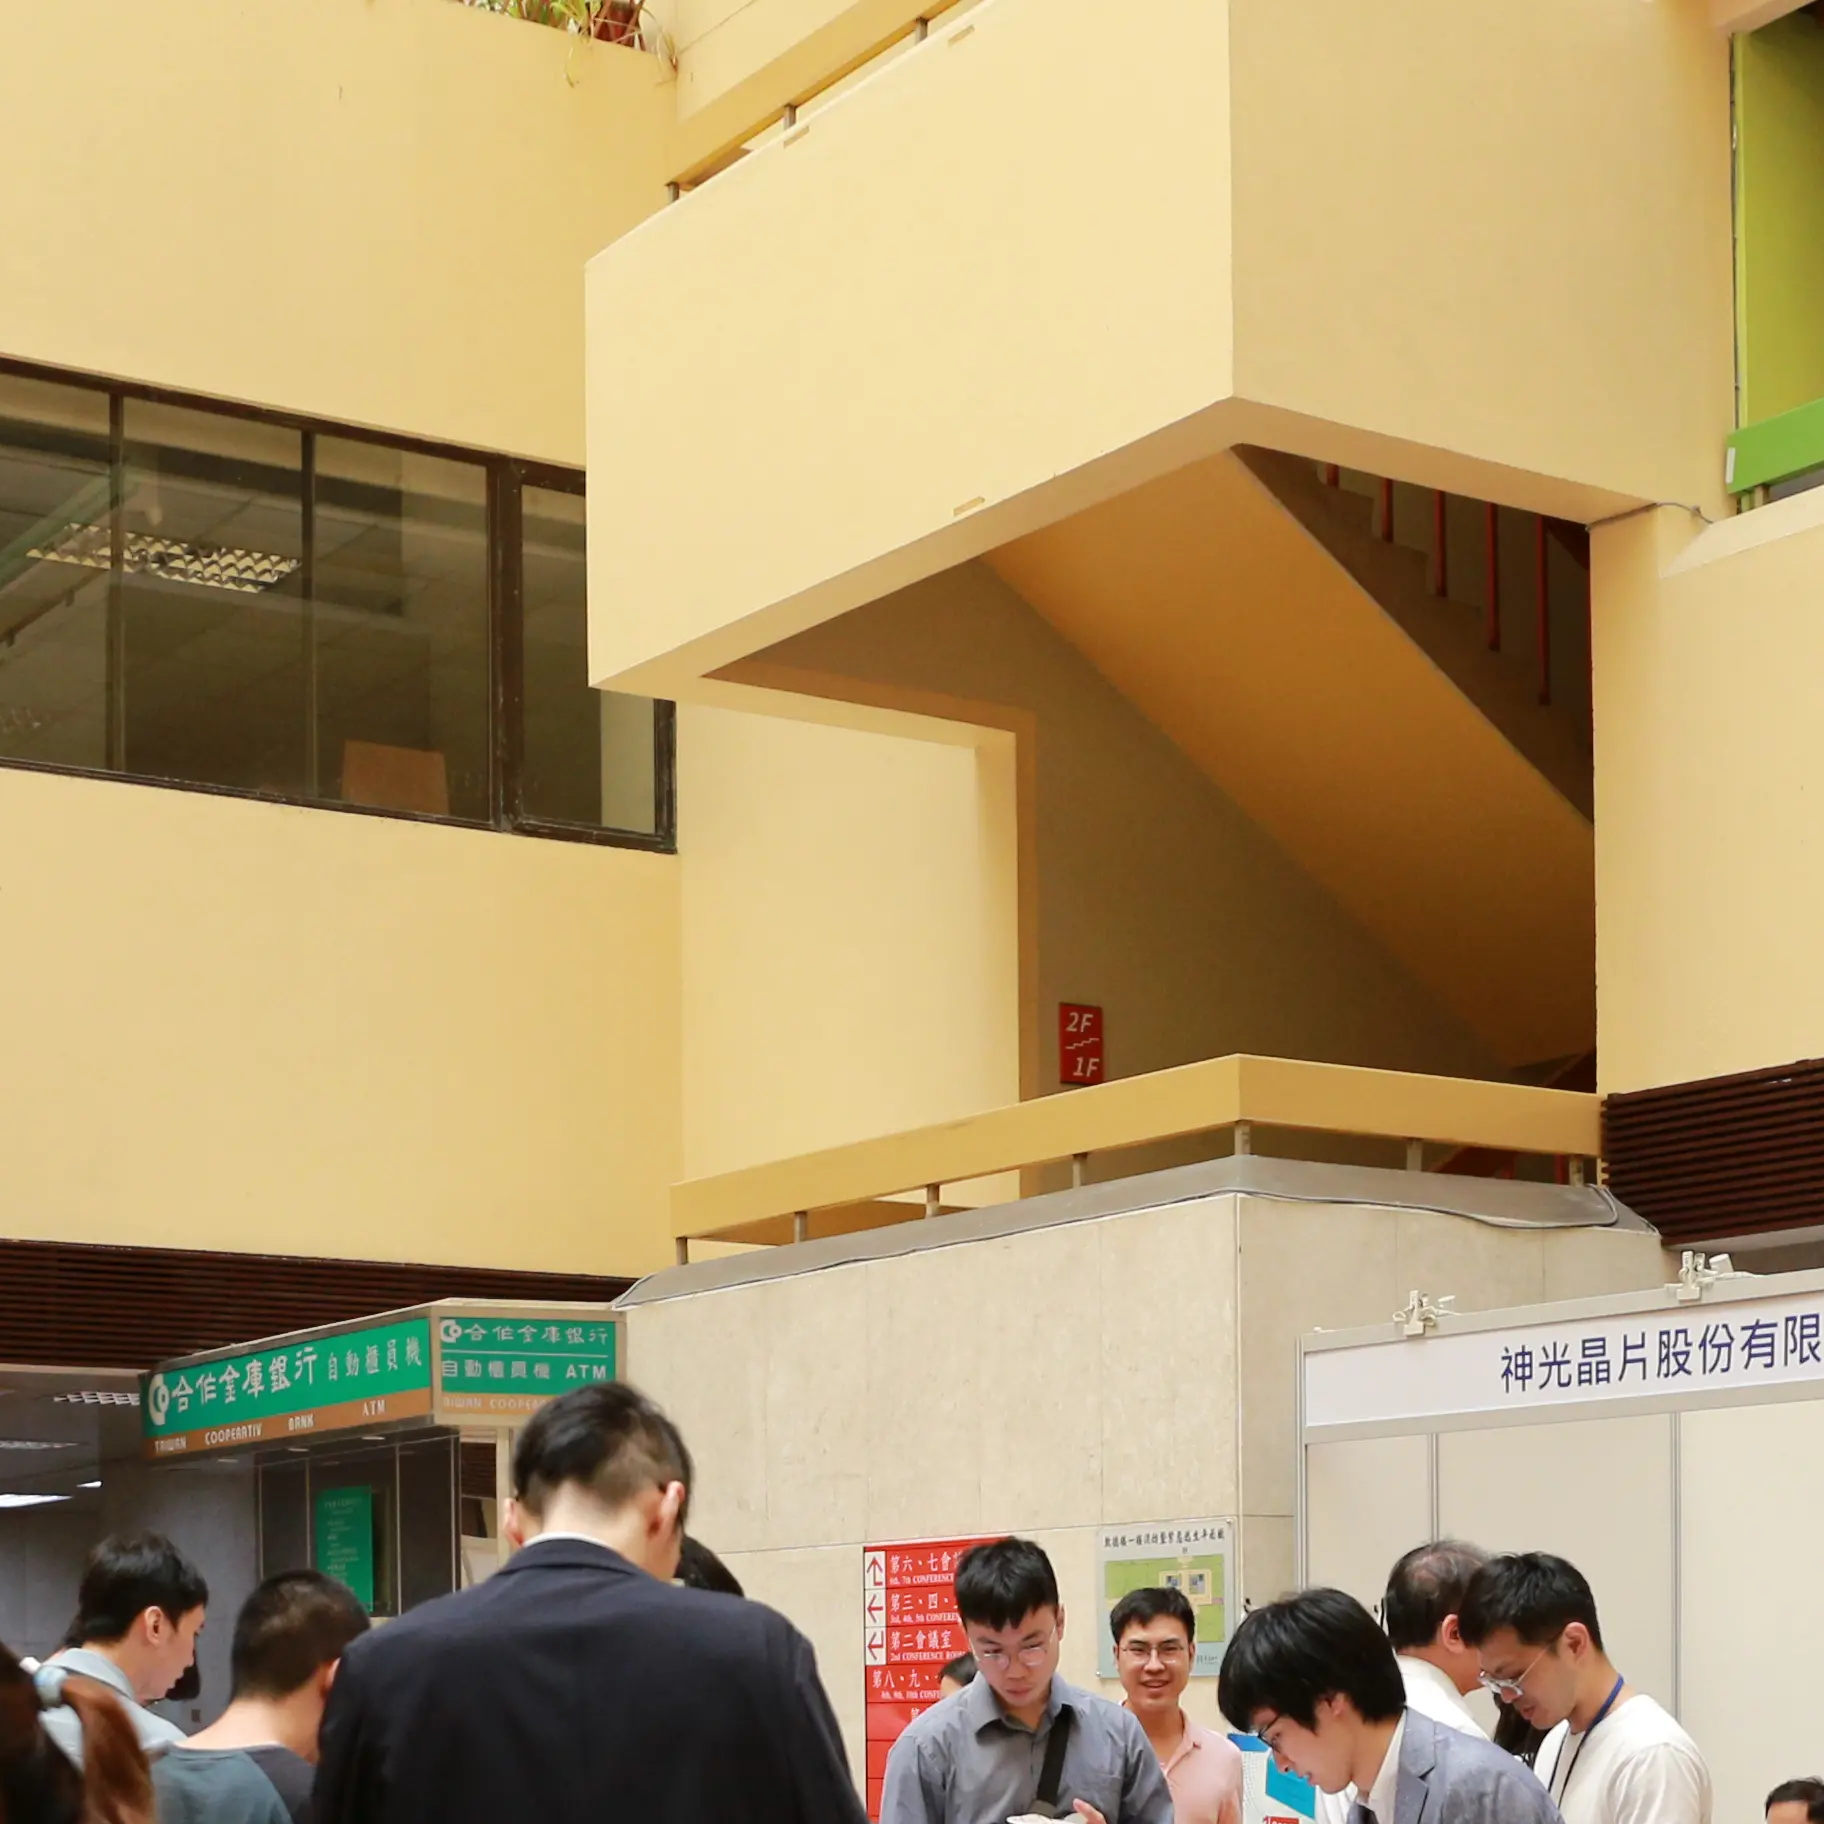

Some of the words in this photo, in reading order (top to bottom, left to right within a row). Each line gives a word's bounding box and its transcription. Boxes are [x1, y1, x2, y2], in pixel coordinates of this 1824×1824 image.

[1065, 1011, 1094, 1033] 2F
[1073, 1056, 1100, 1077] 1F
[464, 1324, 609, 1345] 合作金庫銀行
[172, 1346, 318, 1412] 合作金庫銀行
[328, 1336, 423, 1381] 自動櫃員機
[442, 1360, 551, 1379] 自動櫃員機
[565, 1364, 608, 1379] ATM
[288, 1413, 315, 1431] BANK
[362, 1399, 386, 1416] ATM
[890, 1593, 958, 1612] 第三、四、
[891, 1630, 953, 1650] 第二會議室
[872, 1669, 938, 1688] 第八、九、
